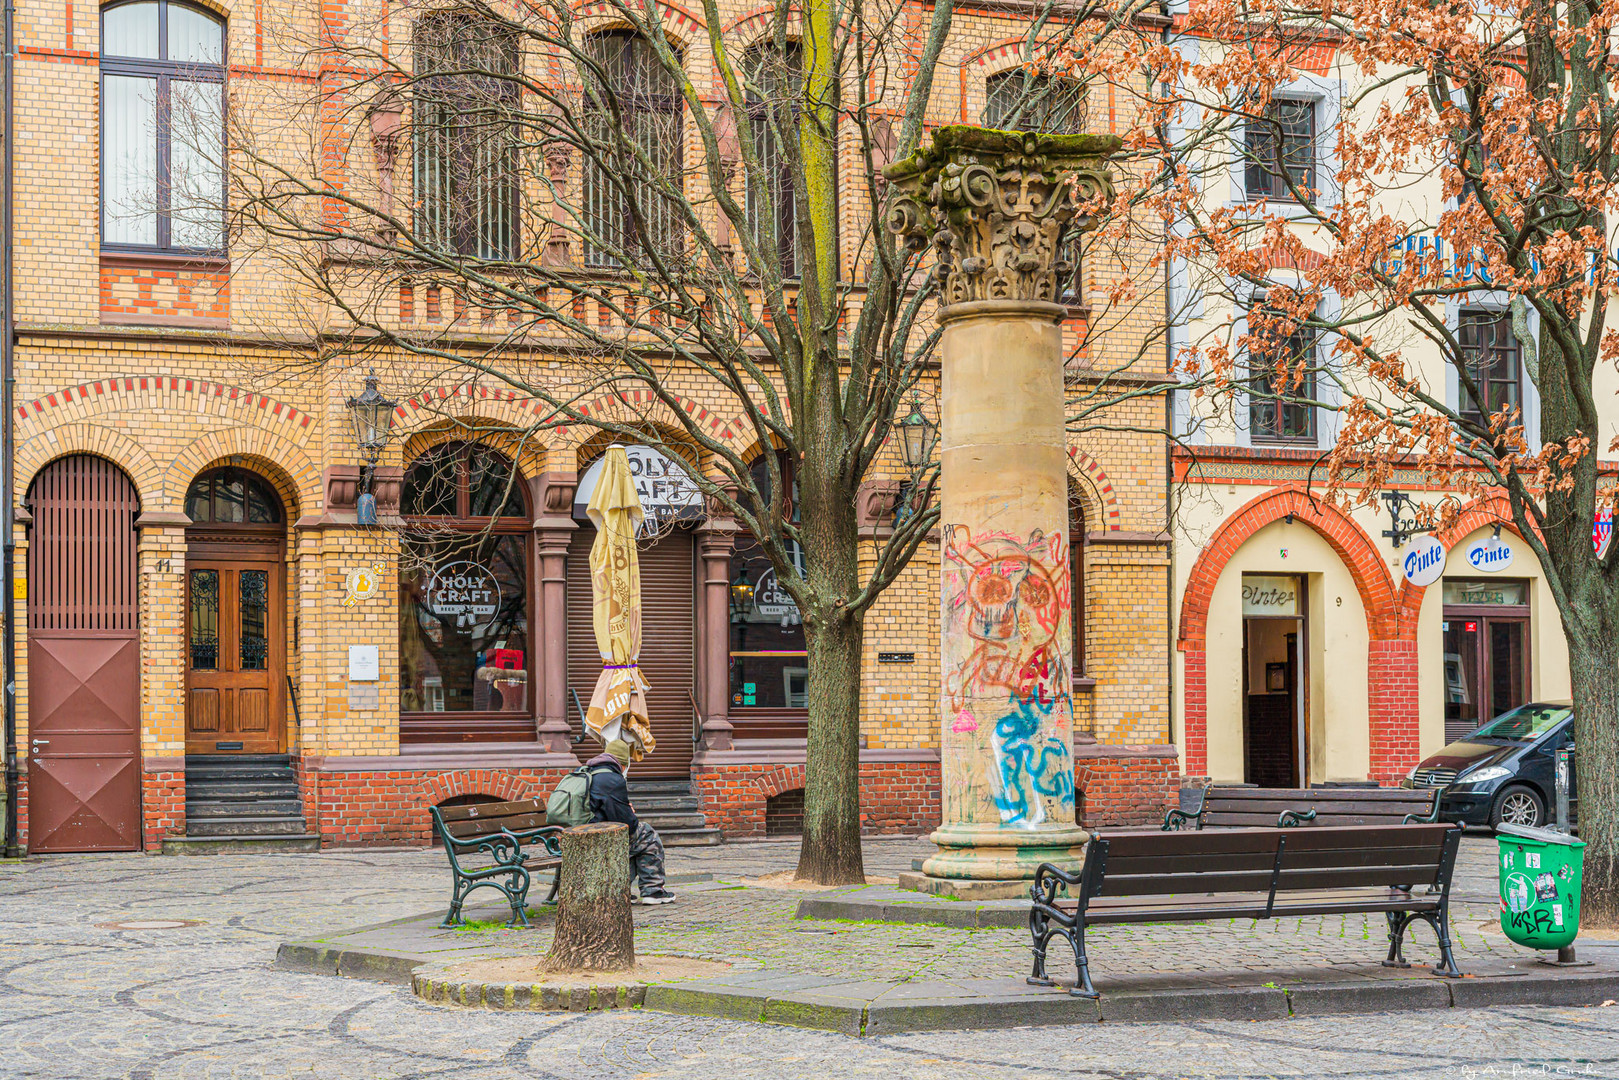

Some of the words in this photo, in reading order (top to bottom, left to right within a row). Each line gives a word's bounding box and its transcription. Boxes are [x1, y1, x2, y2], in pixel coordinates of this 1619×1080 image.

[637, 480, 683, 499] AFT
[1404, 545, 1441, 578] Pinte
[1470, 547, 1510, 566] Pinte
[156, 560, 170, 572] 11
[441, 576, 486, 589] HOLY
[436, 590, 492, 603] CRAFT
[1335, 596, 1343, 607] 9
